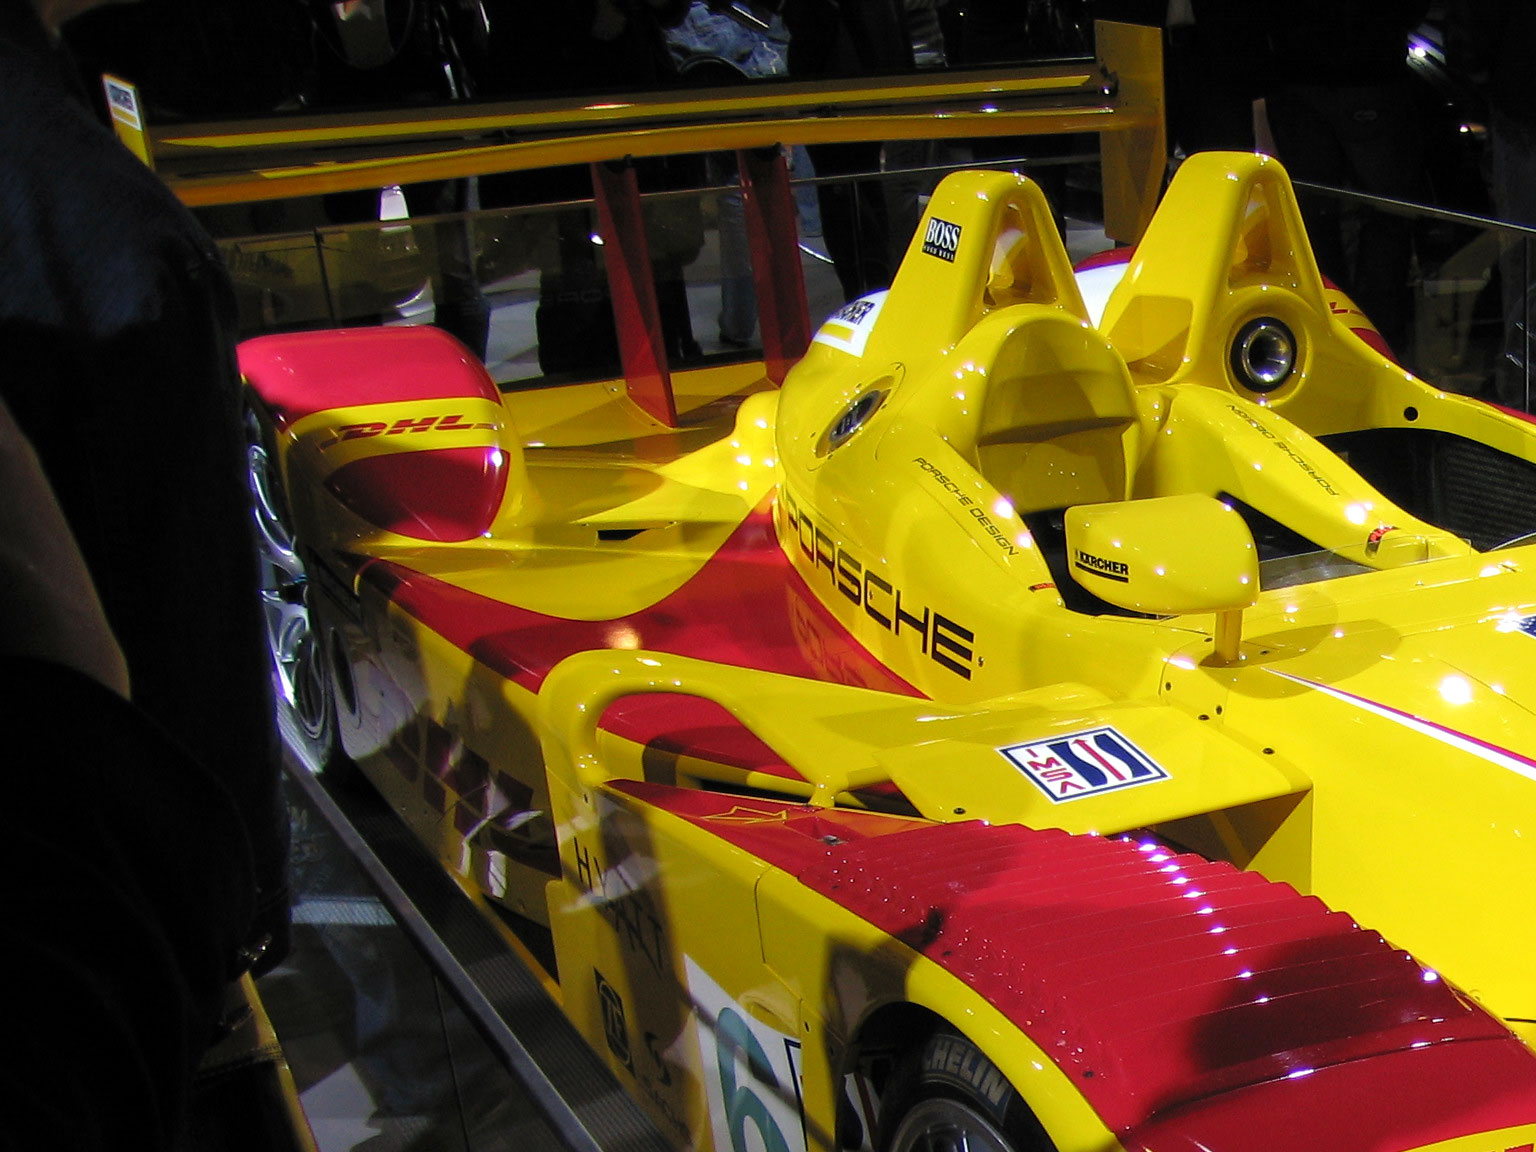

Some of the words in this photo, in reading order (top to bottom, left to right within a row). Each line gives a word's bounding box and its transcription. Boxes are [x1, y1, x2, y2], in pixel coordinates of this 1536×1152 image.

[926, 218, 960, 252] BOSS
[338, 414, 474, 442] DHL
[1273, 441, 1340, 496] PORSCHE
[912, 457, 974, 507] PORSCHE
[969, 507, 1019, 556] DESIGN
[1025, 748, 1087, 795] IMSA
